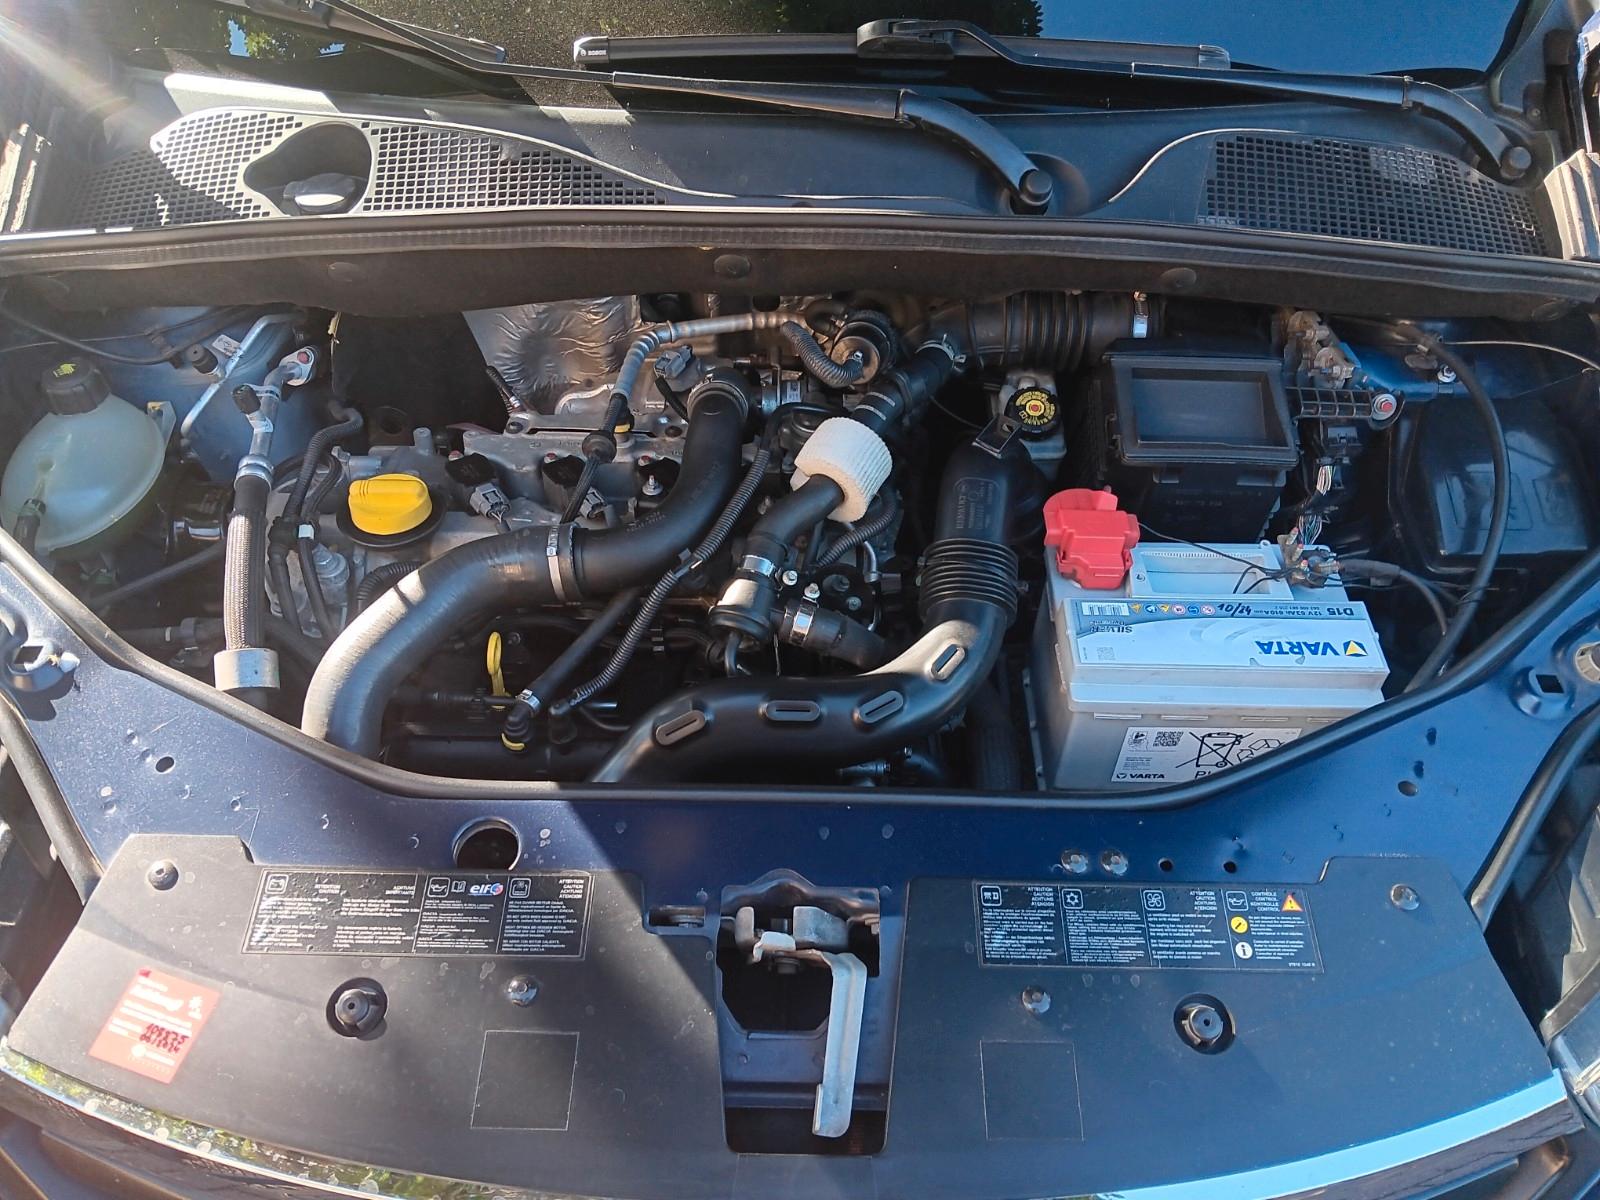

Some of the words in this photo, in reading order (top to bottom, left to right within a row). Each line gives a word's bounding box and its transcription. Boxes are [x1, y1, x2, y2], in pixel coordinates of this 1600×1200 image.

[1217, 603, 1251, 616] 10/24
[1327, 607, 1354, 616] D15
[1254, 640, 1340, 655] VARTA
[470, 884, 492, 893] elf
